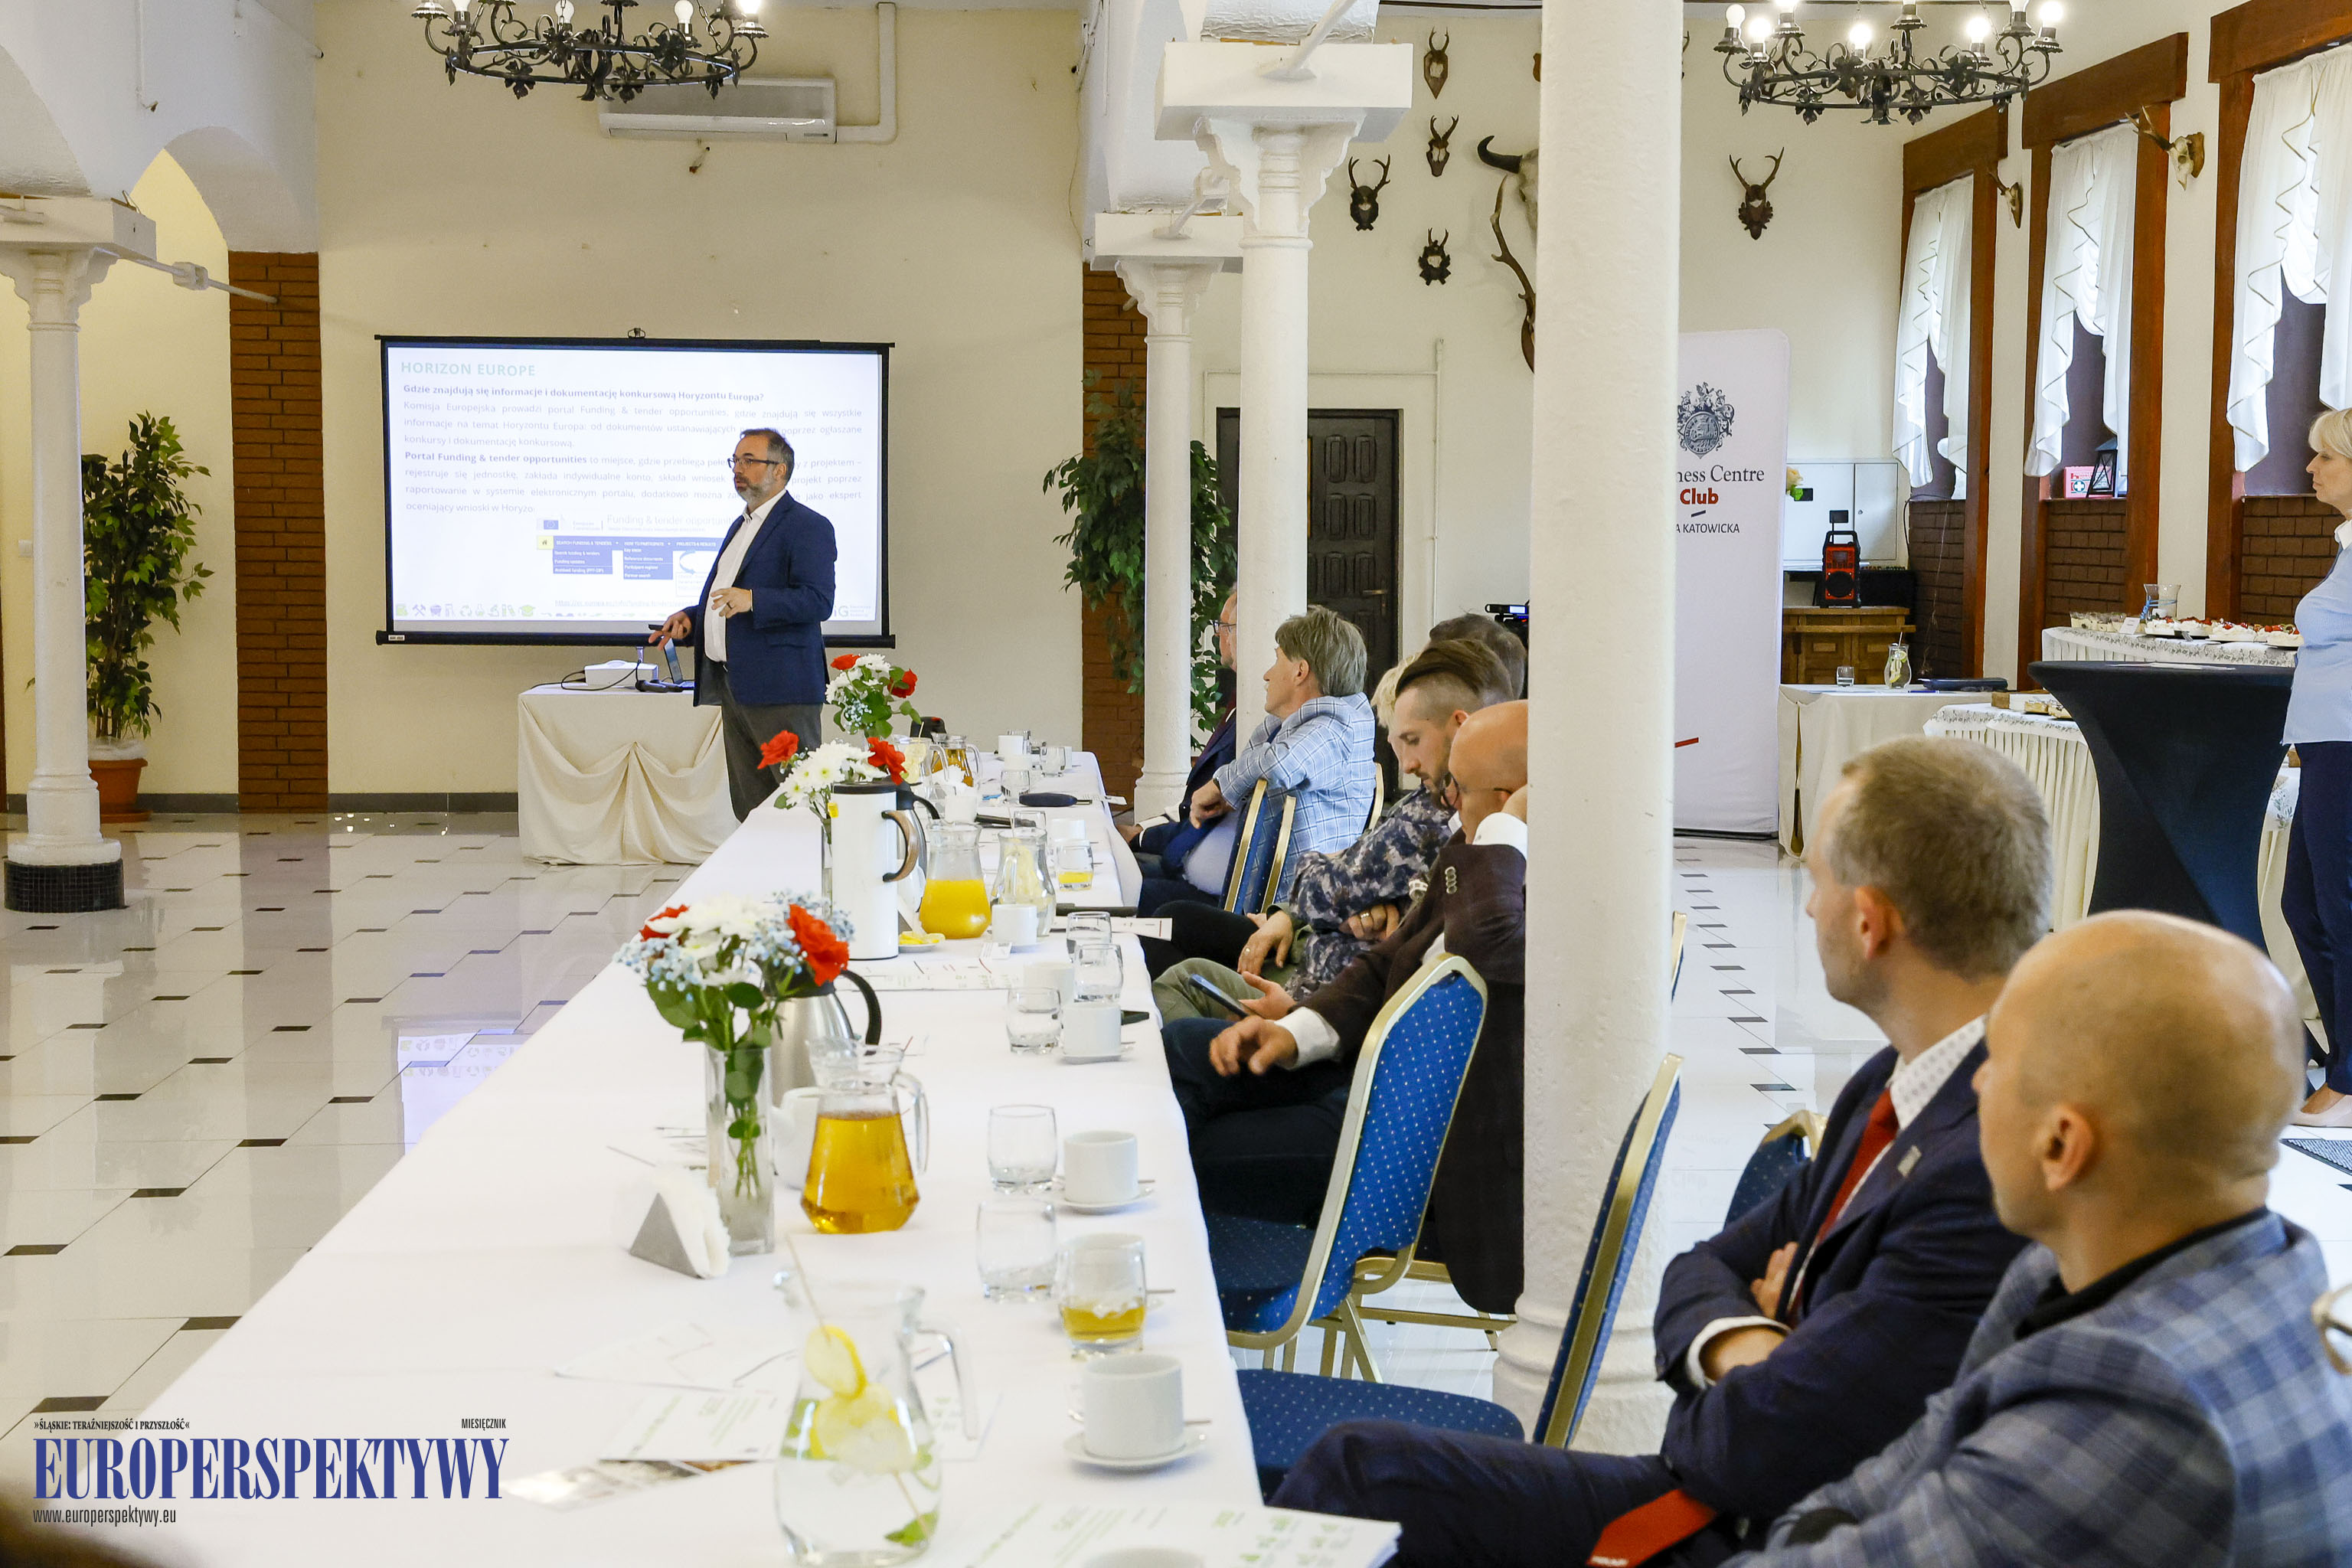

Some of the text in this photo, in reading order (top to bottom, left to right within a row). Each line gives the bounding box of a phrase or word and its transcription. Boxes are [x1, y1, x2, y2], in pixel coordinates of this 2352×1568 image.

[401, 361, 536, 376] HORIZON EUROPE
[403, 384, 430, 394] Gdzie
[433, 385, 473, 397] znajdują
[475, 386, 489, 397] się
[492, 387, 542, 397] informacje
[550, 389, 616, 399] dokumentację
[619, 389, 676, 401] konkursową
[678, 390, 727, 402] Horyzontu
[728, 391, 764, 403] Europa?
[403, 401, 439, 412] Komisja
[446, 402, 495, 414] Europejska
[501, 403, 542, 415] prowadzi
[548, 405, 574, 416] portal
[580, 405, 616, 416] Funding
[634, 406, 662, 415] tender
[734, 408, 756, 420] gdzie
[762, 409, 798, 420] znajdują
[804, 409, 816, 420] się
[822, 407, 862, 420] wszystkie
[403, 419, 452, 430] informacje
[457, 420, 469, 429] na
[472, 420, 498, 429] temat
[503, 421, 549, 432] Horyzontu
[590, 422, 602, 430] od
[606, 423, 663, 433] dokumentów
[667, 423, 736, 436] ustanawiających
[820, 425, 862, 437] ogłaszane
[404, 435, 446, 446] konkursy
[453, 436, 516, 447] dokumentację
[404, 452, 435, 461] Portal
[438, 452, 476, 464] Funding
[479, 453, 486, 462] &
[489, 453, 521, 462] tender
[523, 455, 587, 466] opportunities
[638, 456, 661, 467] gdzie
[664, 457, 705, 468] przebiega
[810, 459, 854, 469] projektem
[405, 468, 449, 479] rejestruje
[455, 469, 467, 480] się
[524, 472, 557, 481] zakłada
[564, 472, 621, 482] indywidualne
[658, 473, 686, 482] składa
[691, 474, 726, 483] wniosek
[792, 475, 822, 485] projekt
[828, 475, 862, 485] poprzez
[1710, 464, 1765, 482] Centre
[405, 485, 467, 496] raportowanie
[485, 487, 525, 498] systemie
[531, 487, 597, 499] elektronicznym
[641, 490, 688, 499] dodatkowo
[805, 492, 824, 502] jako
[829, 490, 862, 501] ekspert
[1680, 487, 1719, 505] Club
[406, 503, 454, 514] oceniający
[456, 504, 489, 513] wnioski
[607, 514, 644, 527] Funding
[1683, 523, 1740, 534] KATOWICKA
